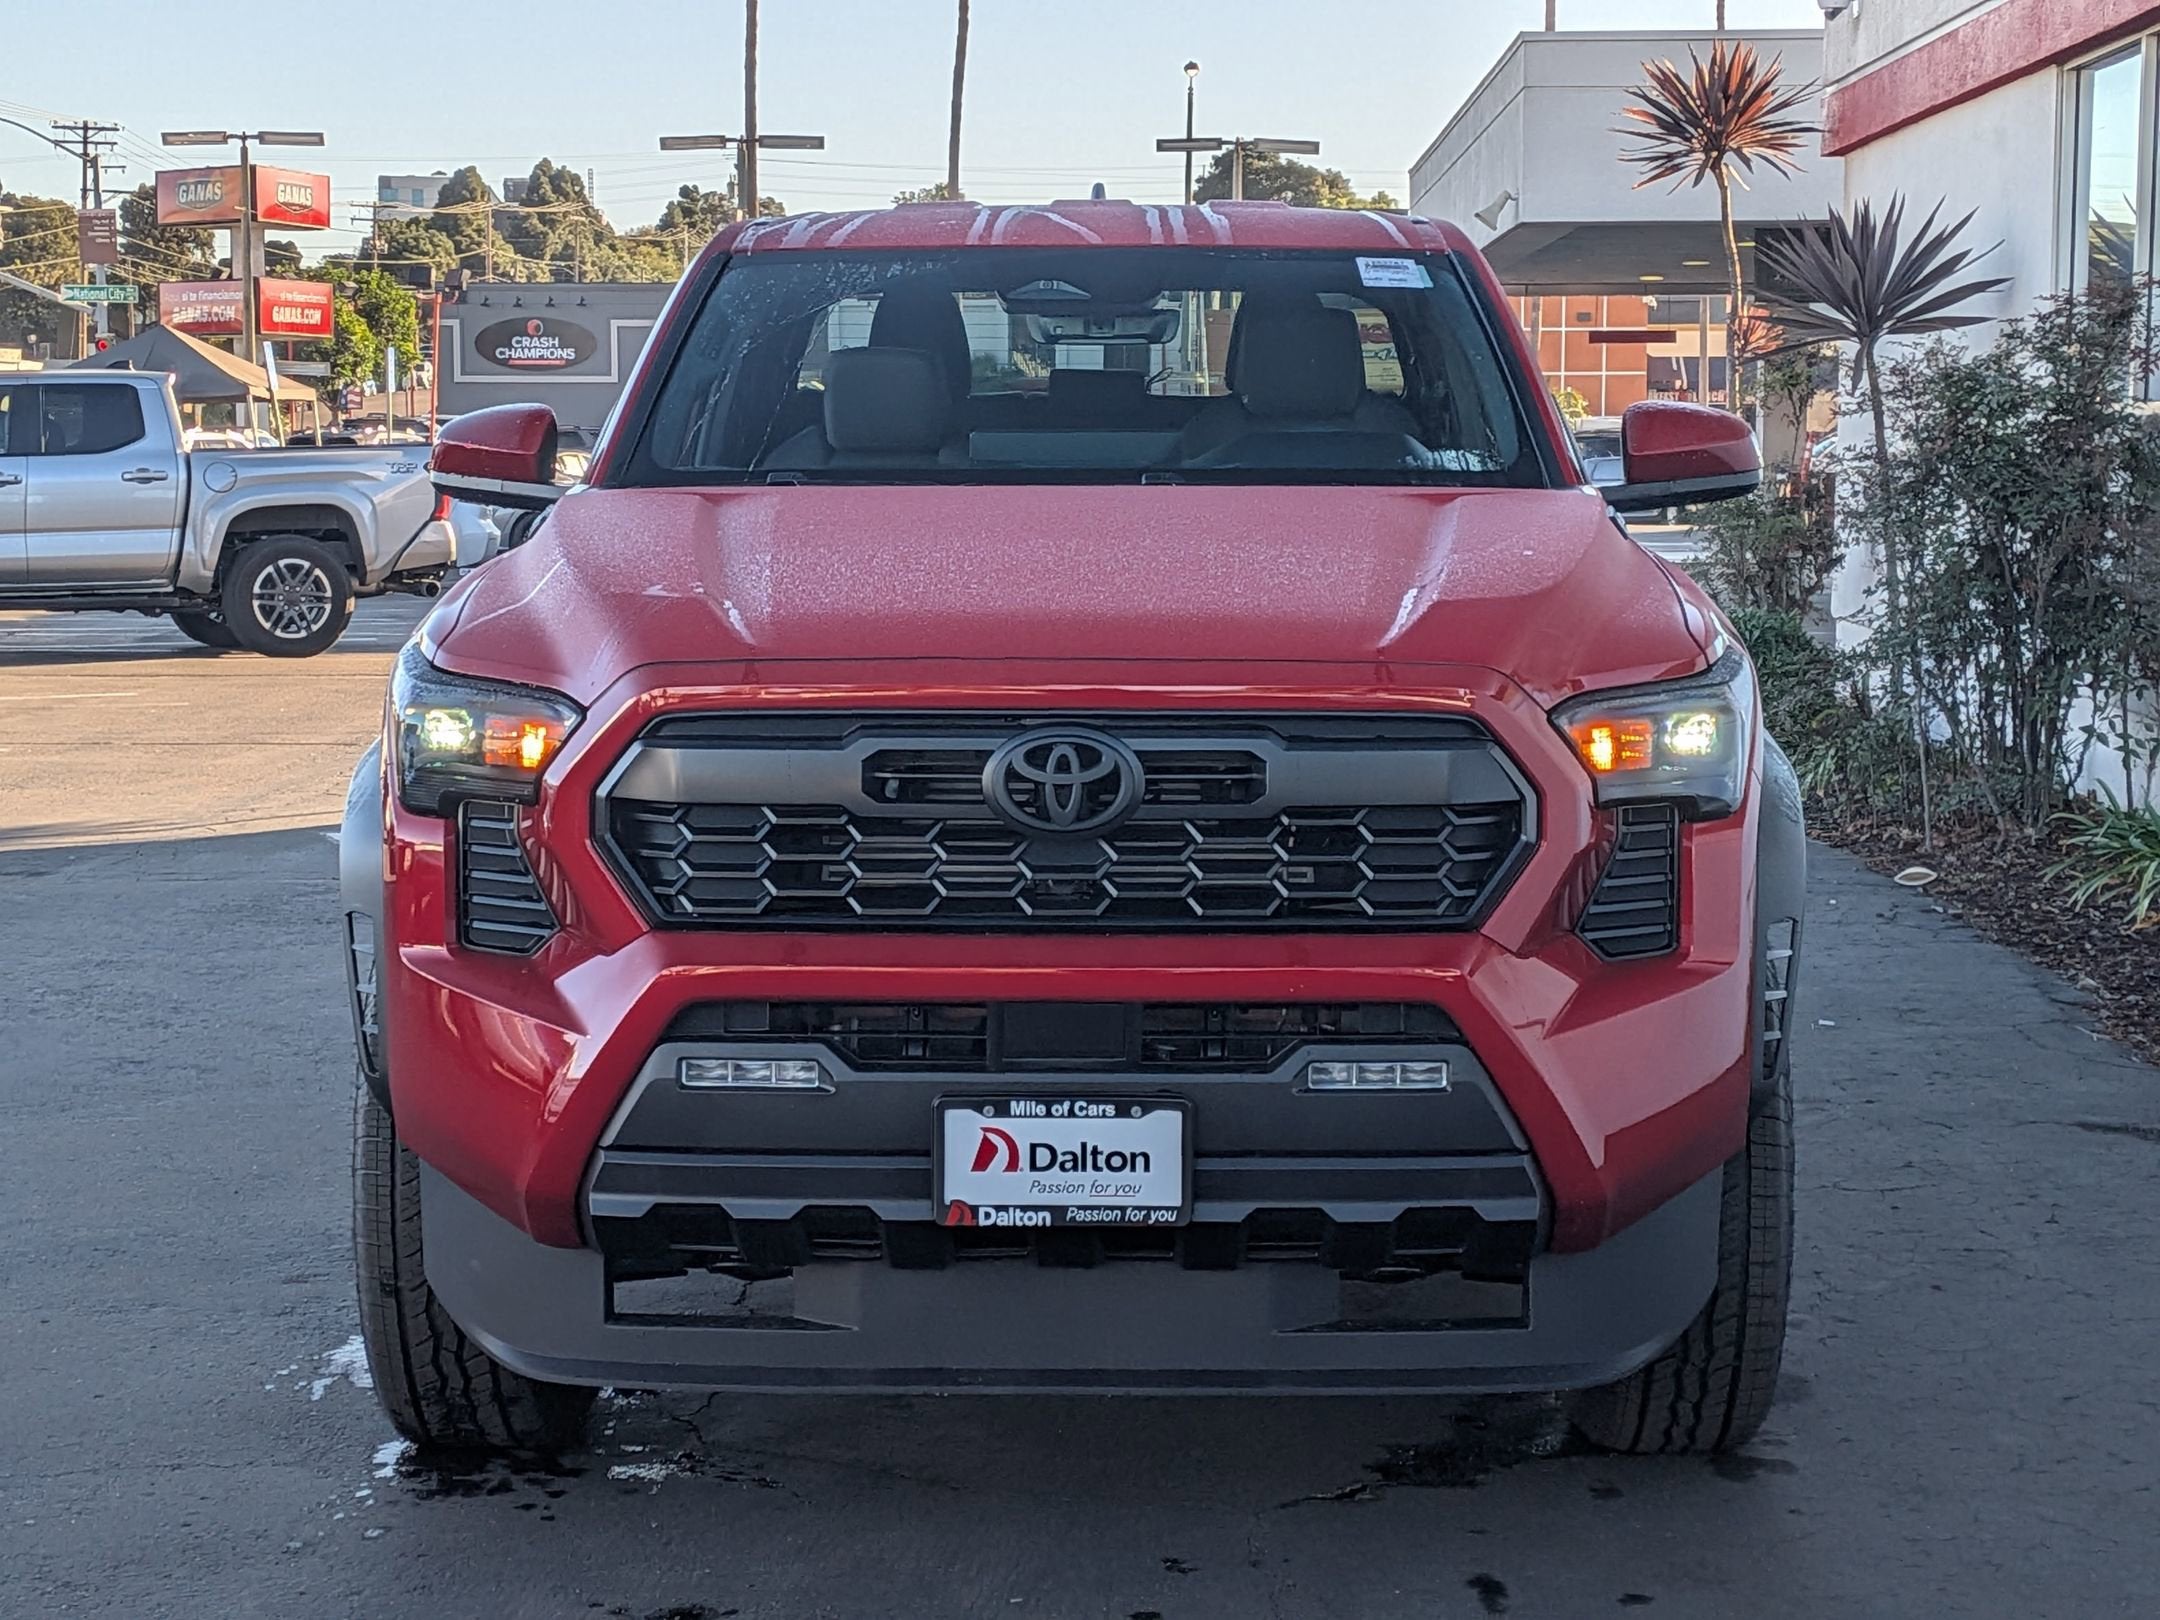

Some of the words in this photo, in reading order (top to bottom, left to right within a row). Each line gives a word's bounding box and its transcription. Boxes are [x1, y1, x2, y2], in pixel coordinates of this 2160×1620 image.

[179, 182, 222, 203] GANAS
[277, 183, 312, 206] GANAS
[73, 287, 107, 300] National
[108, 288, 125, 301] City
[172, 305, 236, 323] GANAS.COM
[272, 305, 322, 325] GANAS.COM
[511, 335, 559, 348] CRASH
[495, 347, 576, 360] CHAMPIONS
[1010, 1100, 1046, 1116] Mile
[1050, 1100, 1070, 1116] of
[1074, 1100, 1116, 1116] Cars
[1029, 1141, 1151, 1173] Dalton
[1028, 1180, 1084, 1194] Passion
[1088, 1179, 1112, 1195] for
[1113, 1183, 1142, 1196] you
[978, 1206, 1052, 1227] Dalton
[1066, 1206, 1121, 1222] Passion
[1123, 1206, 1146, 1223] for
[1147, 1209, 1177, 1225] you
